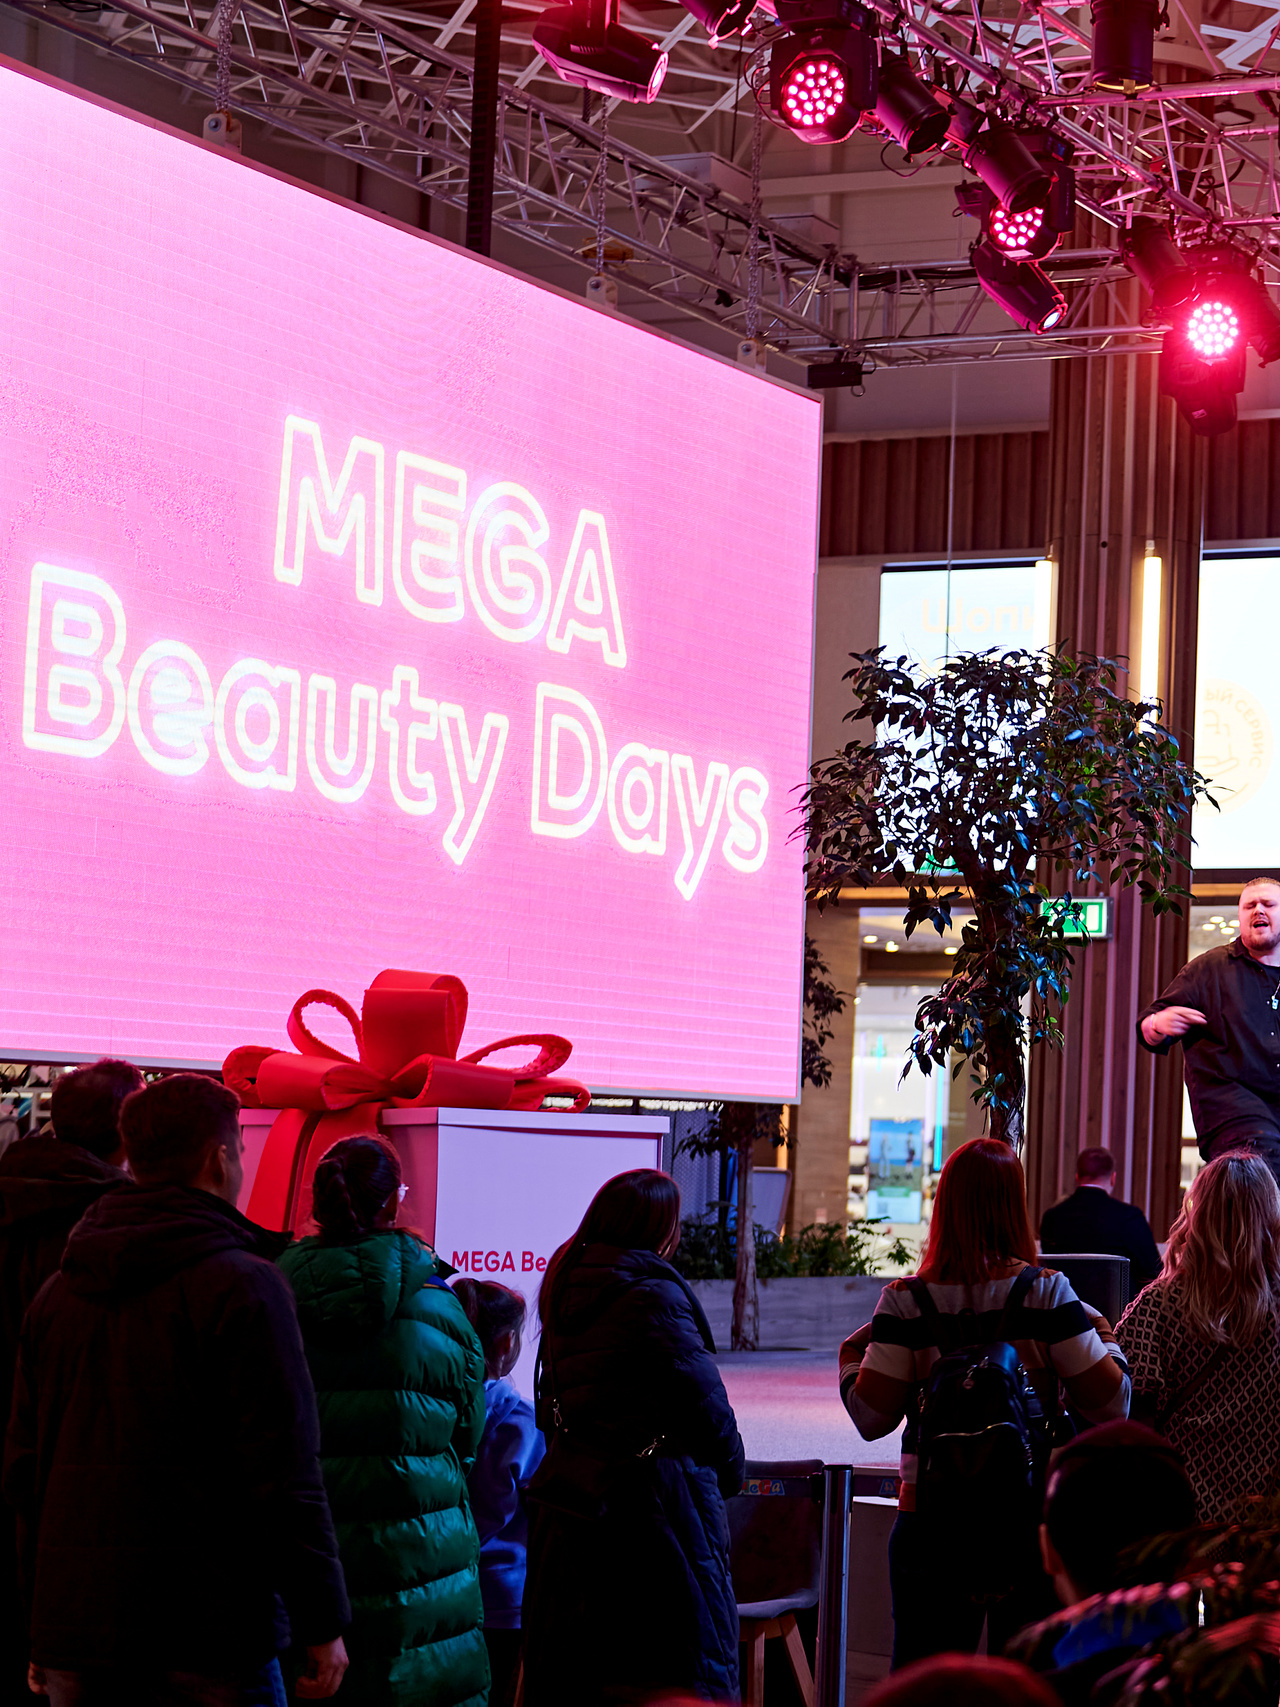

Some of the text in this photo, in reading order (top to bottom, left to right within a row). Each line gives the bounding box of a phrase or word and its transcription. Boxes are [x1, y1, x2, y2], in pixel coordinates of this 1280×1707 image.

[273, 413, 627, 670] MEGA
[21, 560, 770, 901] Beauty Days
[1234, 698, 1265, 769] СЕРВИС
[451, 1250, 547, 1273] MEGA Be
